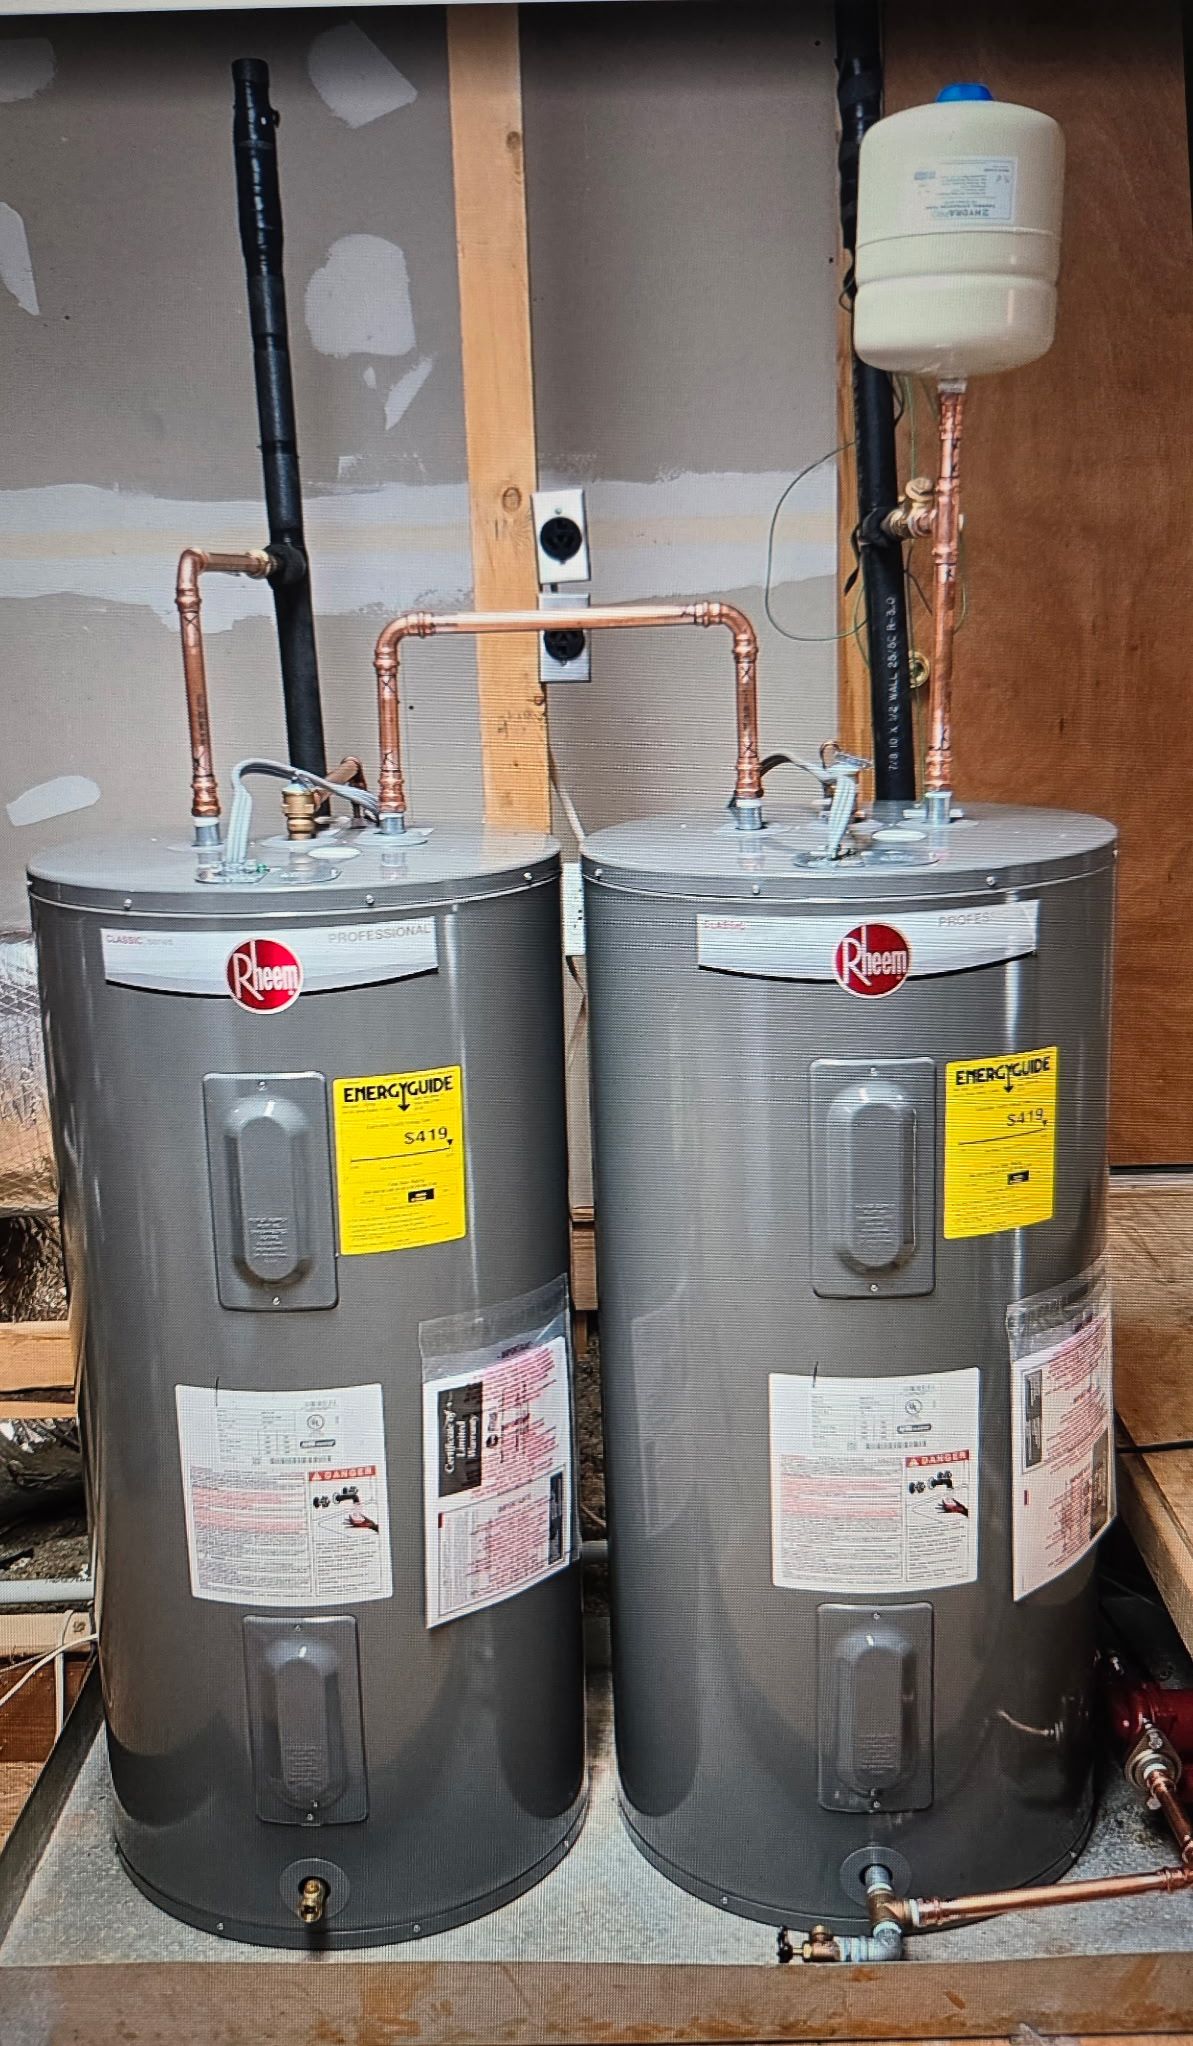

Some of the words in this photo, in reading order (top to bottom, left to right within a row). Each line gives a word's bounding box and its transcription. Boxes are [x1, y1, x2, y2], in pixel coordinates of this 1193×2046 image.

[888, 672, 898, 701] WALL
[327, 922, 433, 943] PROFESSIONAL
[233, 941, 298, 1000] Rheem
[842, 926, 907, 986] Rheem
[956, 1056, 1050, 1085] ENERGYGUIDE
[344, 1076, 453, 1104] ENERGYGUIDE
